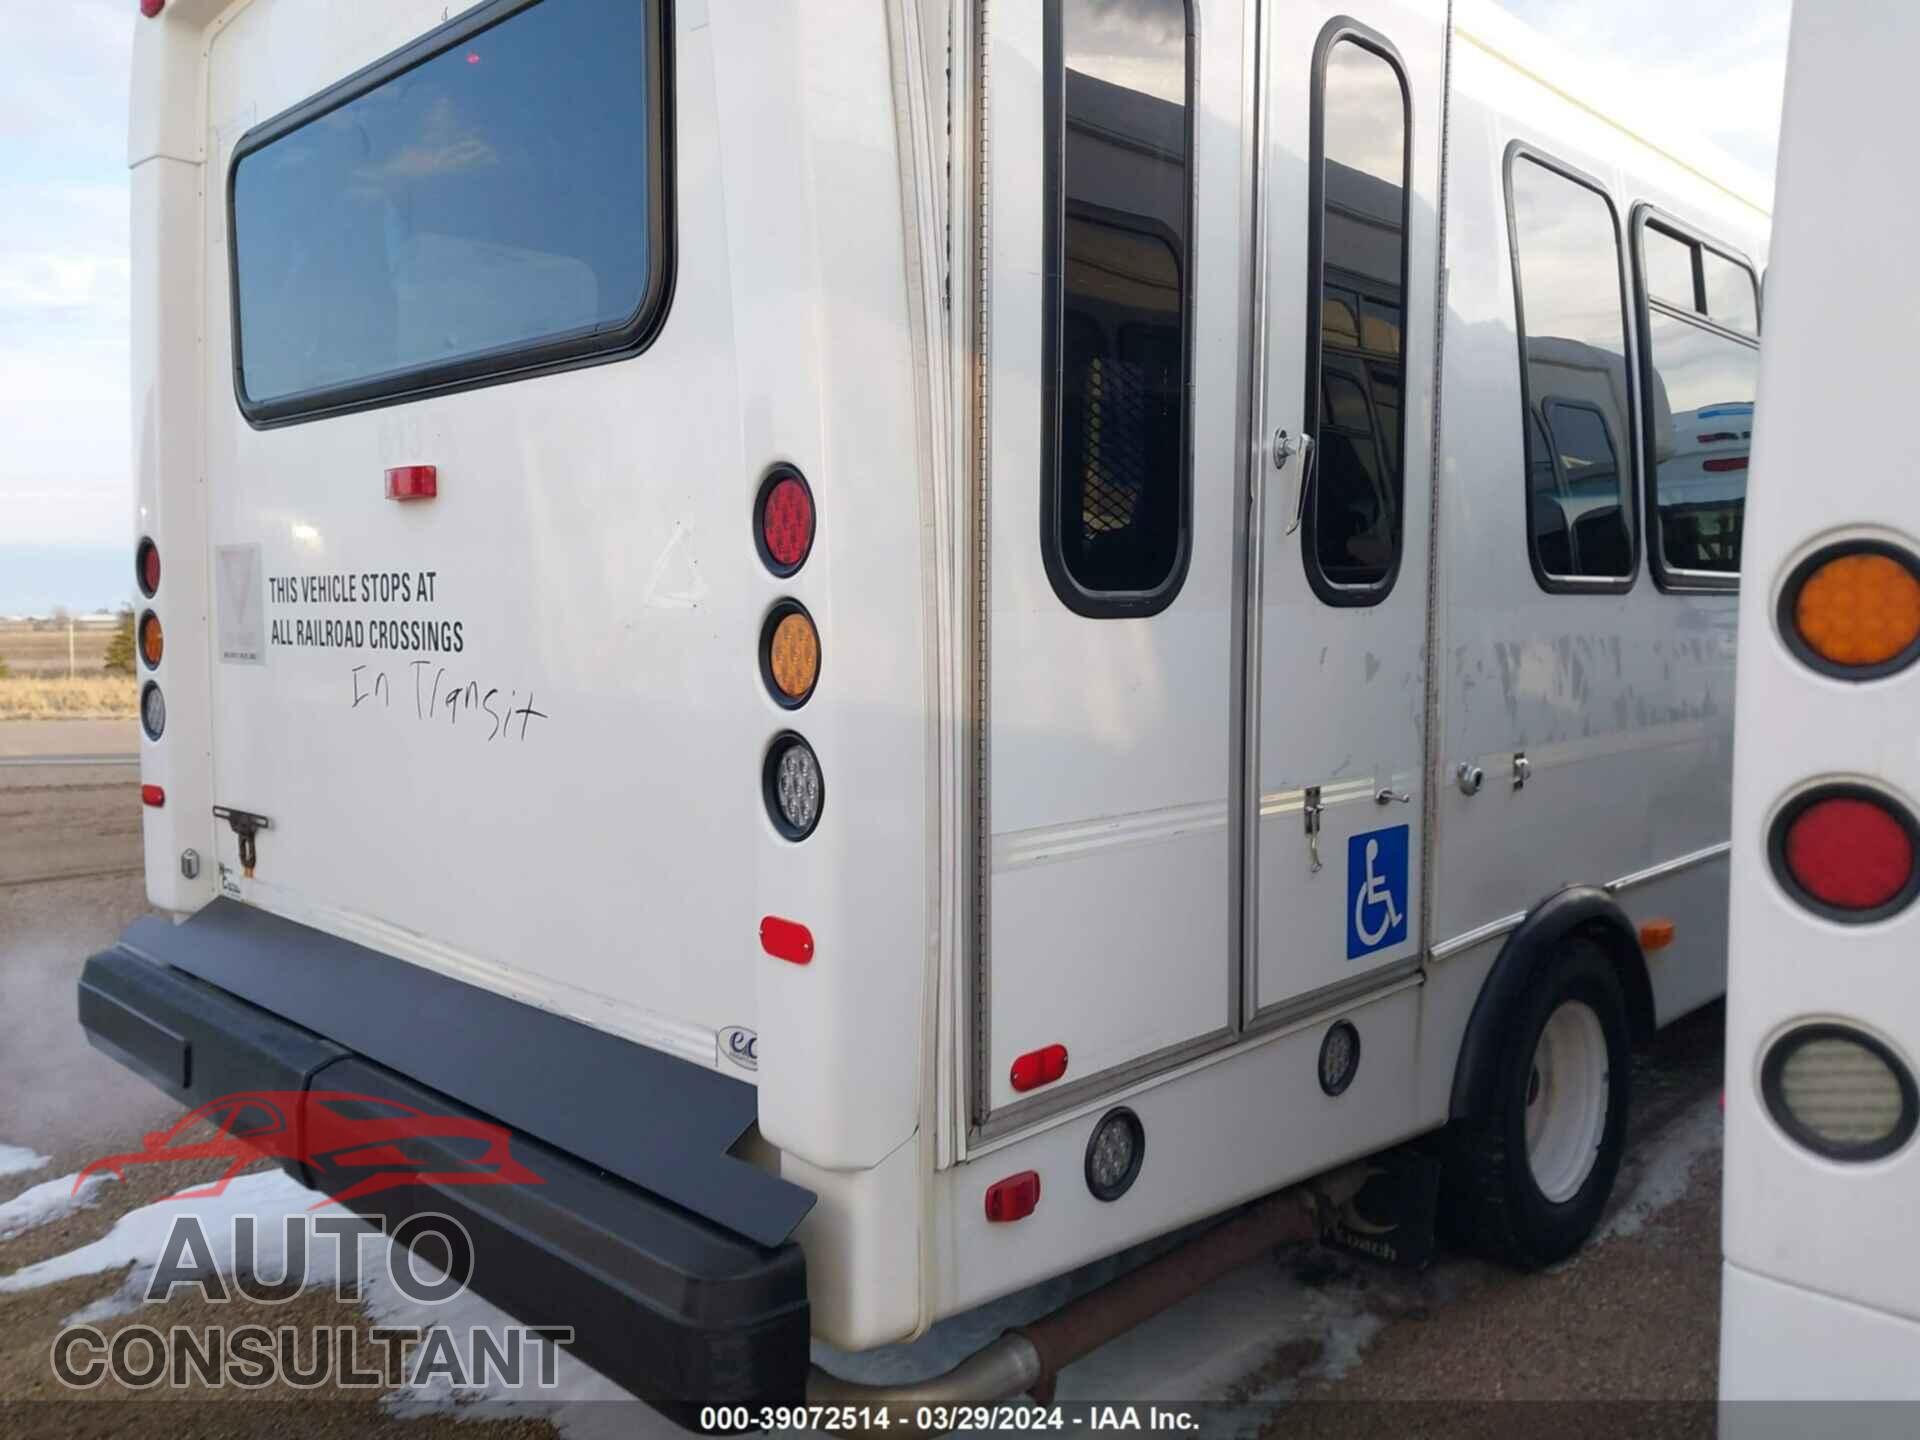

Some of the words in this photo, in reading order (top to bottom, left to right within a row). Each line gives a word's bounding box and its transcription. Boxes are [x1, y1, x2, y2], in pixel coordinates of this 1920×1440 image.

[269, 576, 297, 603] THIS
[301, 574, 356, 602] VEHICLE
[361, 572, 411, 602] STOPS
[416, 571, 437, 602] AT
[271, 619, 293, 646] ALL
[296, 619, 365, 648] RAILROAD
[369, 620, 465, 652] CROSSINGS
[352, 665, 389, 708] In
[410, 660, 548, 741] Transit
